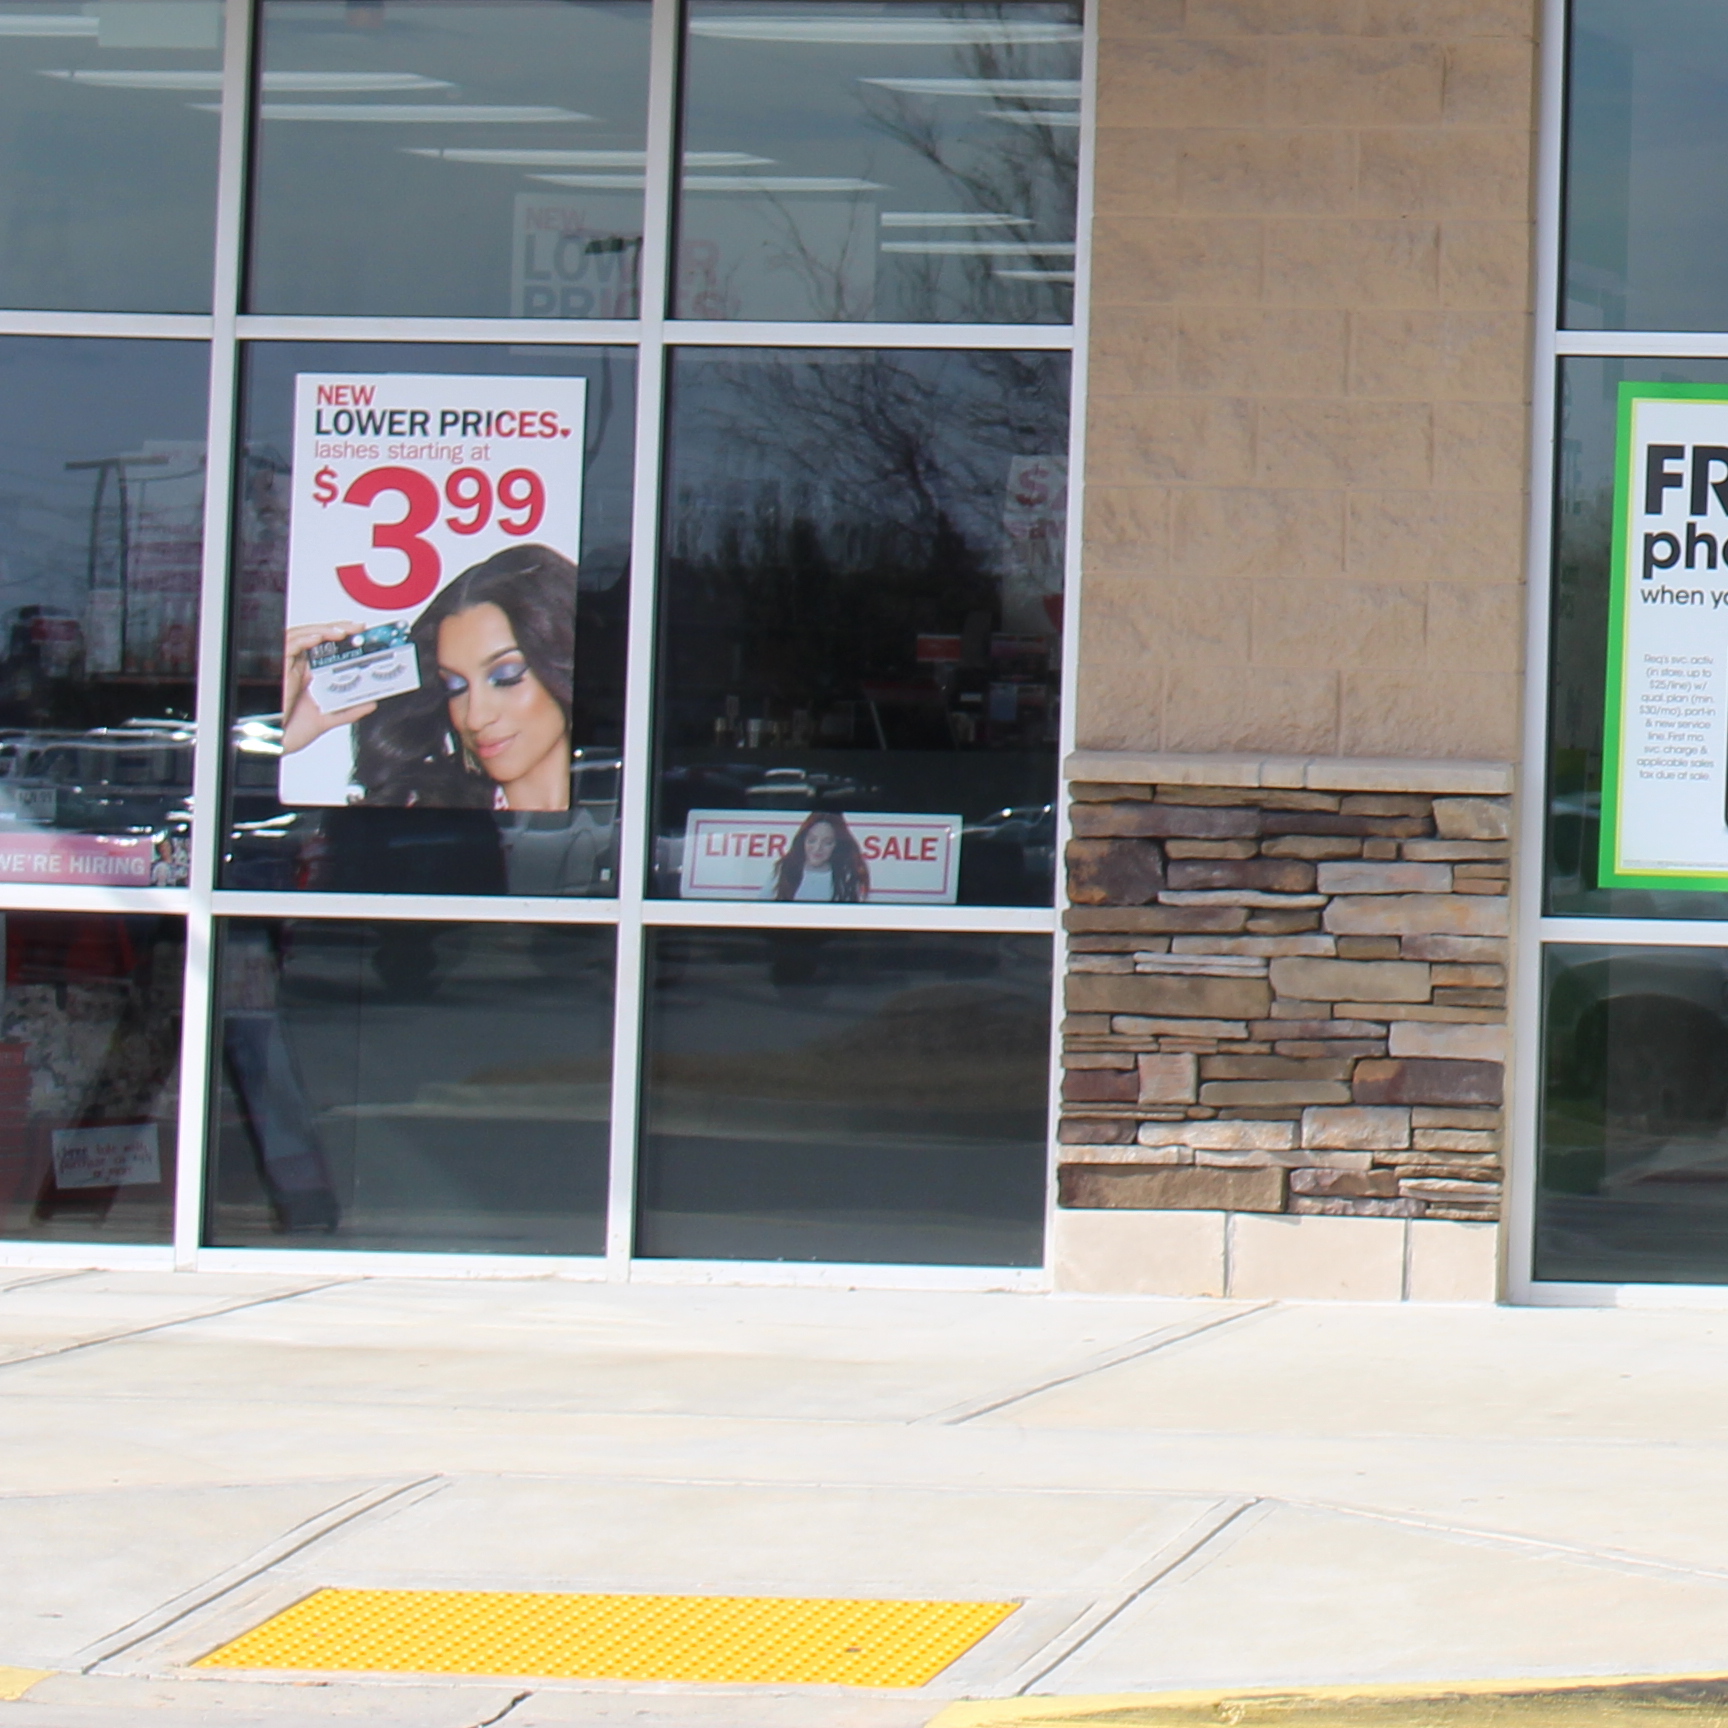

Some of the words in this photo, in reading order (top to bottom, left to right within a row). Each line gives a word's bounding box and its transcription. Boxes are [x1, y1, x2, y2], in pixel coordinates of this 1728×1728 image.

[524, 233, 720, 283] LOWR
[317, 385, 376, 406] NEW
[315, 409, 430, 437] LOWER
[314, 441, 380, 460] lashes
[388, 442, 463, 464] starting
[471, 443, 491, 461] at
[1640, 585, 1704, 605] when
[705, 832, 788, 858] LITER
[863, 836, 939, 862] SALE
[69, 855, 145, 876] HIRING
